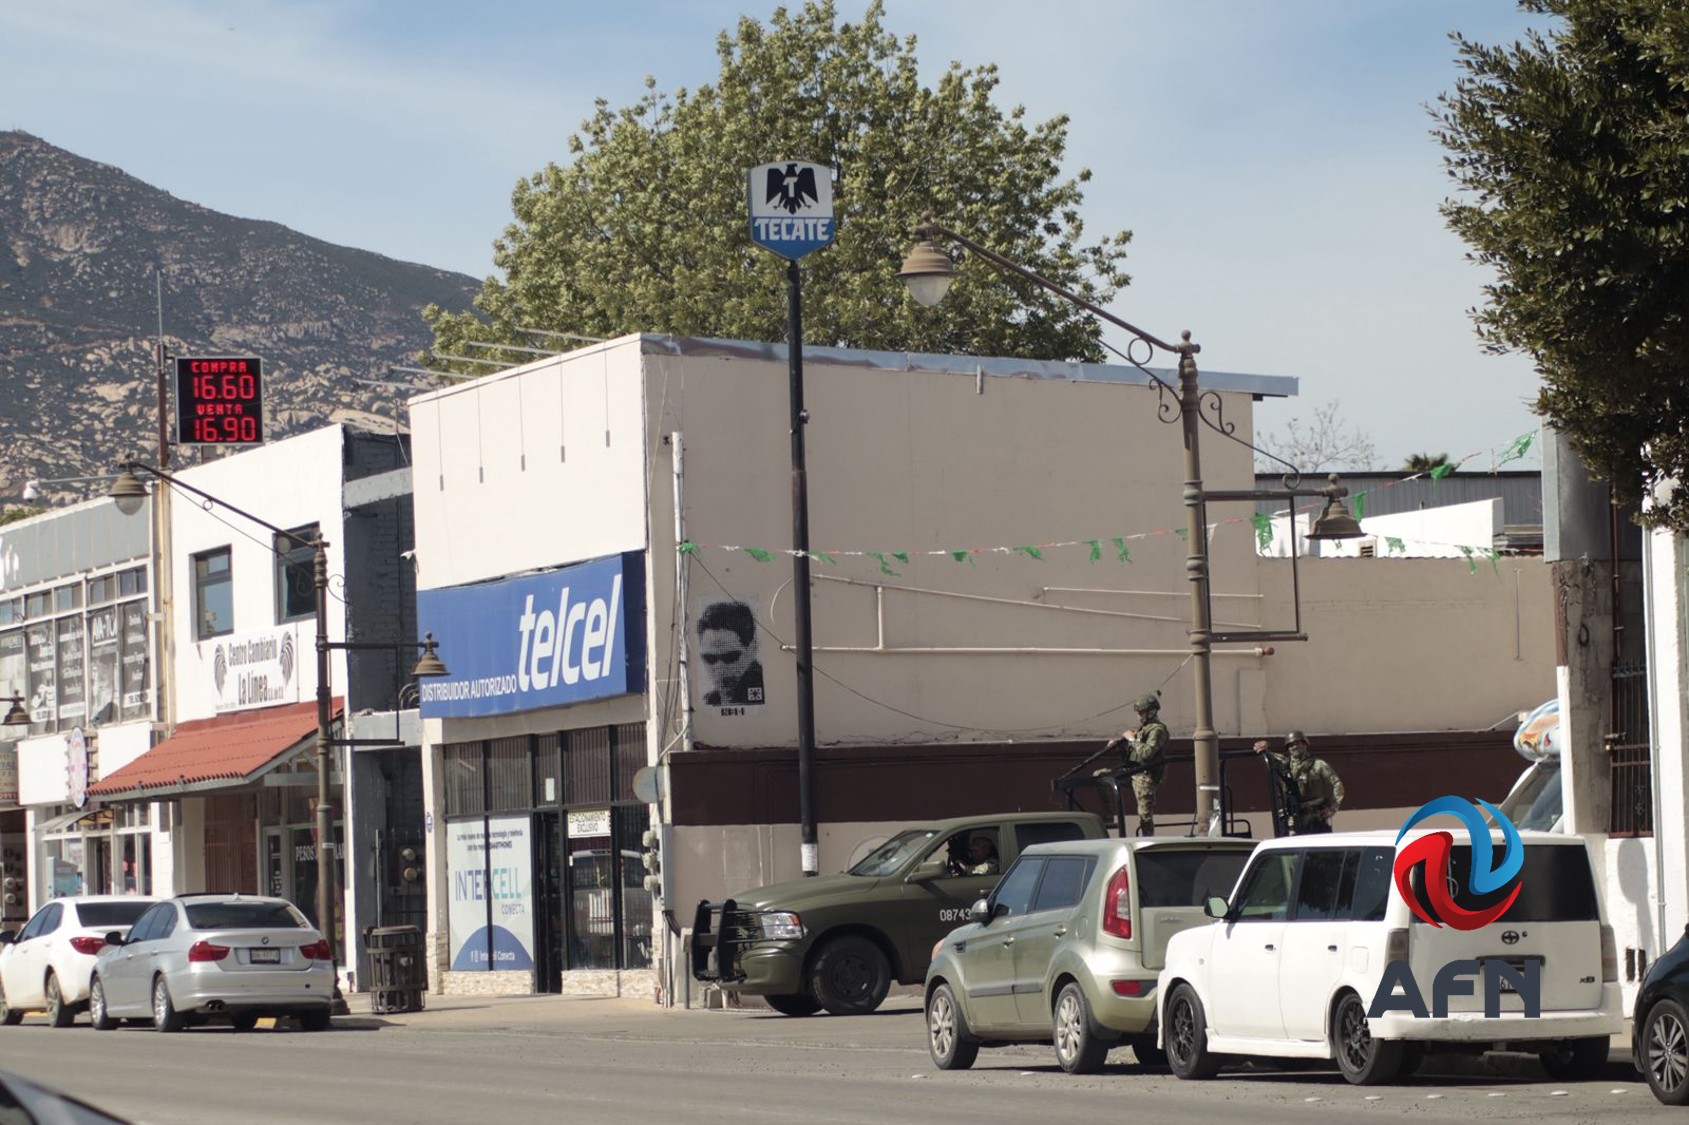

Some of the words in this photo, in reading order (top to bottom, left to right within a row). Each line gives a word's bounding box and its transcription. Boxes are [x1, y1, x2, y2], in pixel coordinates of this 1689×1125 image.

[754, 218, 830, 241] TECATE
[191, 361, 247, 373] COMPRA
[193, 375, 254, 400] 16.60
[196, 403, 243, 416] VENTA
[194, 417, 256, 442] 16.90
[518, 573, 622, 693] telcel
[228, 642, 247, 667] Centro
[248, 635, 277, 664] Cambiario
[238, 672, 246, 705] La
[422, 679, 469, 702] DISTRIBUIDOR
[470, 674, 517, 698] AUTORIZADO
[940, 908, 971, 921] 08743
